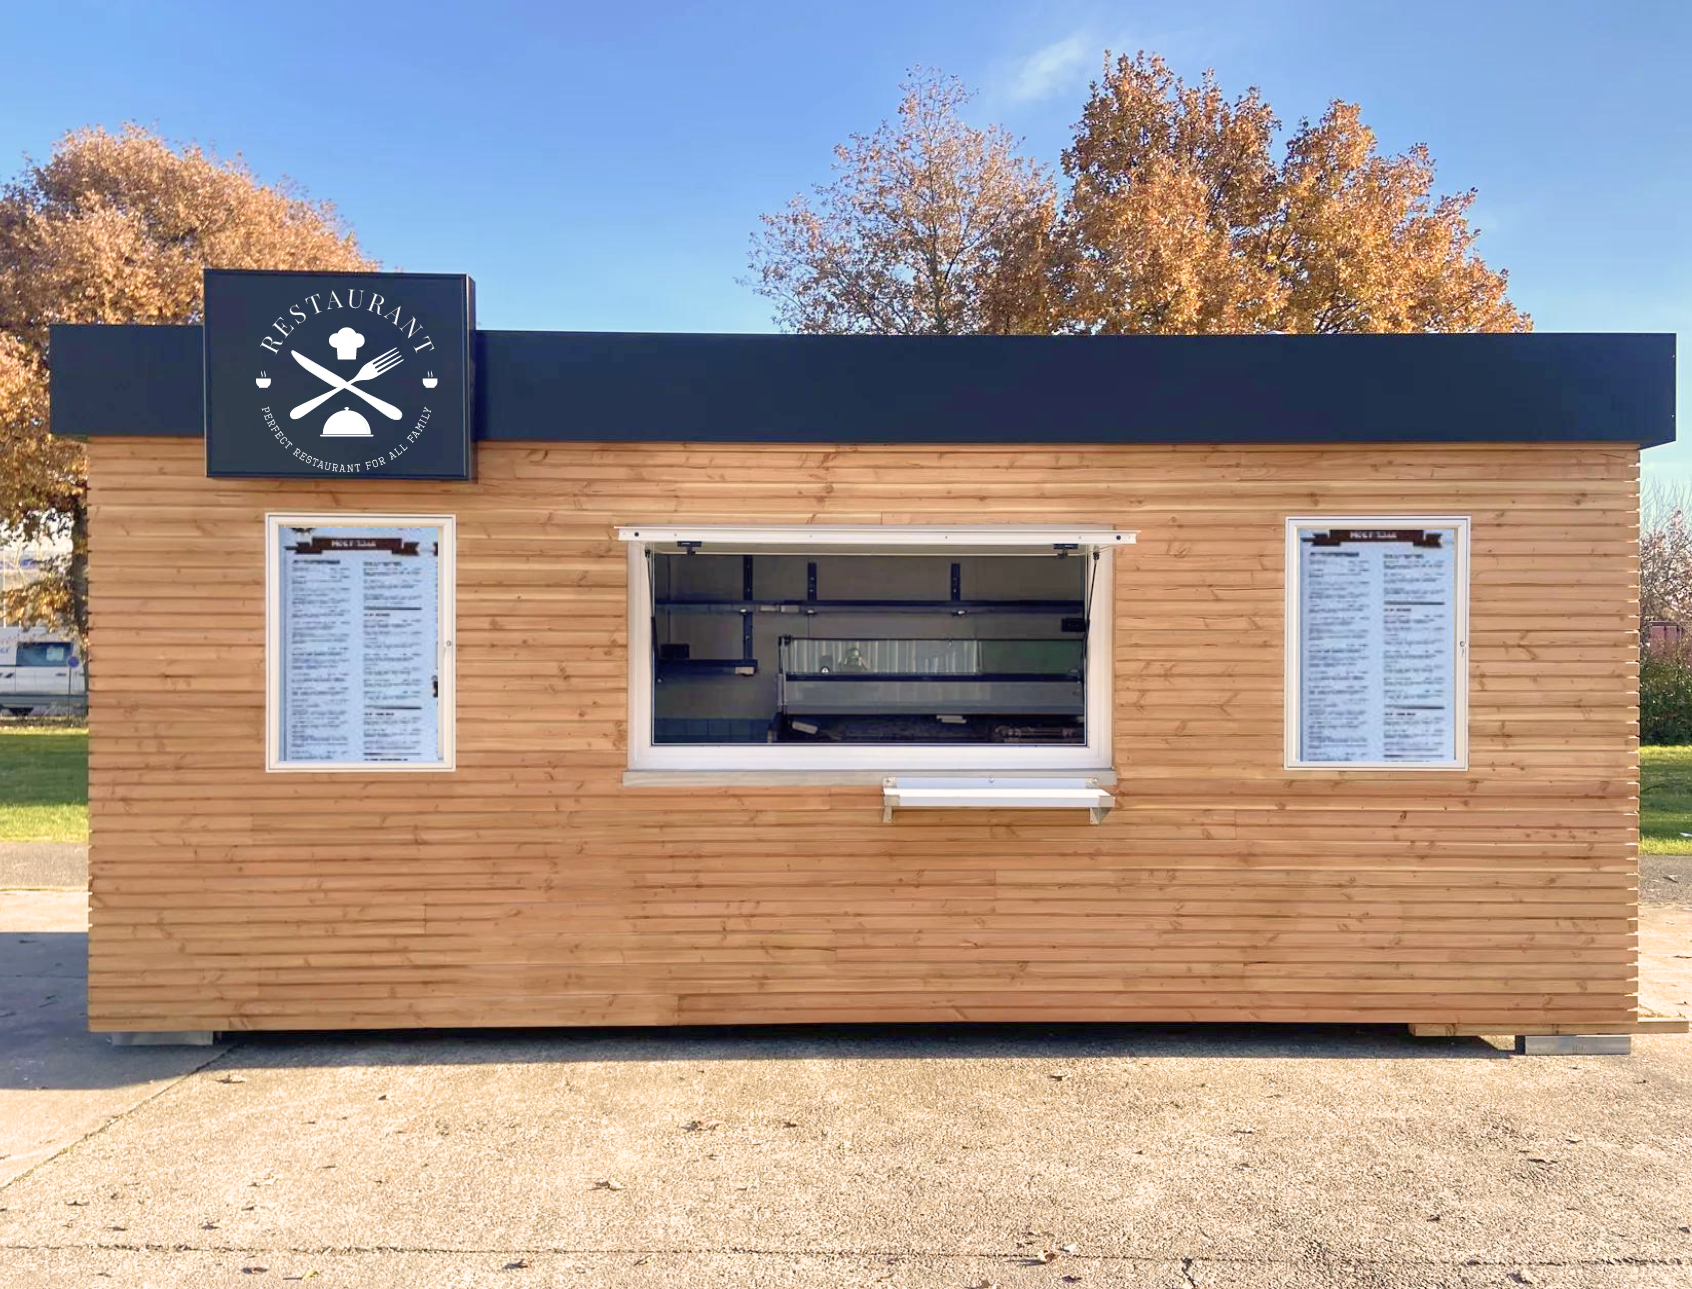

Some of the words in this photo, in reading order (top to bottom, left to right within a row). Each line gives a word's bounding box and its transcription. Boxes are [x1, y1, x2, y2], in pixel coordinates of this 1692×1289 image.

[260, 289, 434, 354] RESTAURANT
[261, 406, 293, 450] PERFECT
[292, 447, 361, 473] RESTAURANT
[365, 456, 386, 471] FOR
[389, 444, 408, 461] ALL
[407, 406, 432, 443] FAMILY
